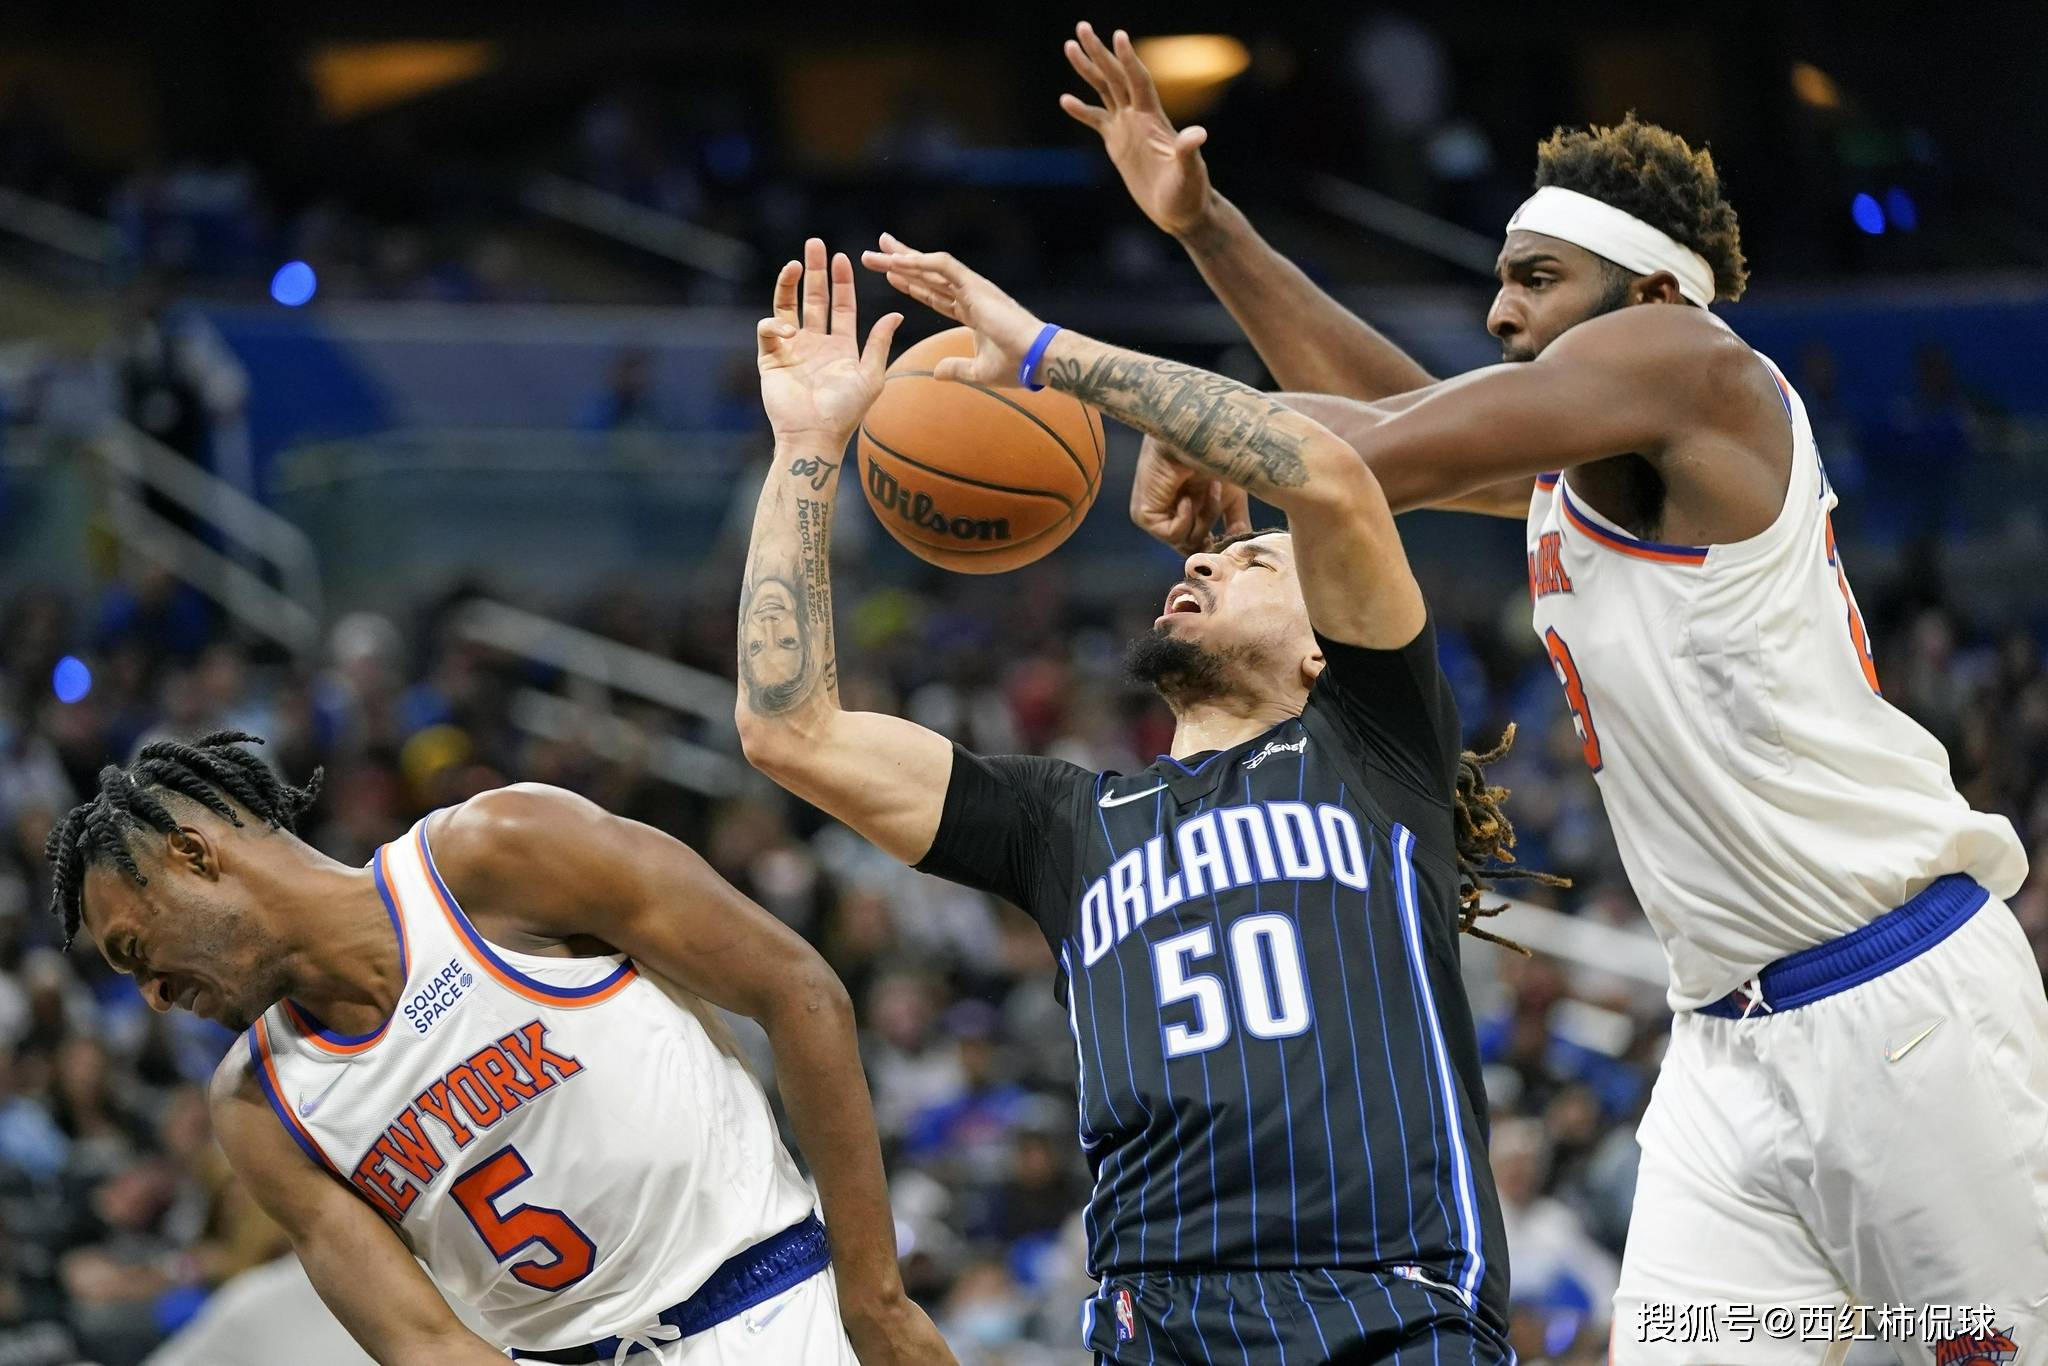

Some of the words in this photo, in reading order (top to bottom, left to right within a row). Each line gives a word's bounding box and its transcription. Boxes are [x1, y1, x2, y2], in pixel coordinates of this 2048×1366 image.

[788, 455, 838, 491] Leo
[868, 456, 1011, 540] Wilson
[1529, 531, 1574, 607] RK
[1080, 799, 1370, 970] ORLANDO
[404, 958, 463, 1020] SQUARE
[414, 982, 463, 1034] SPACE
[1151, 911, 1314, 1060] 50
[414, 1018, 587, 1152] YORK
[447, 1143, 598, 1293] 5
